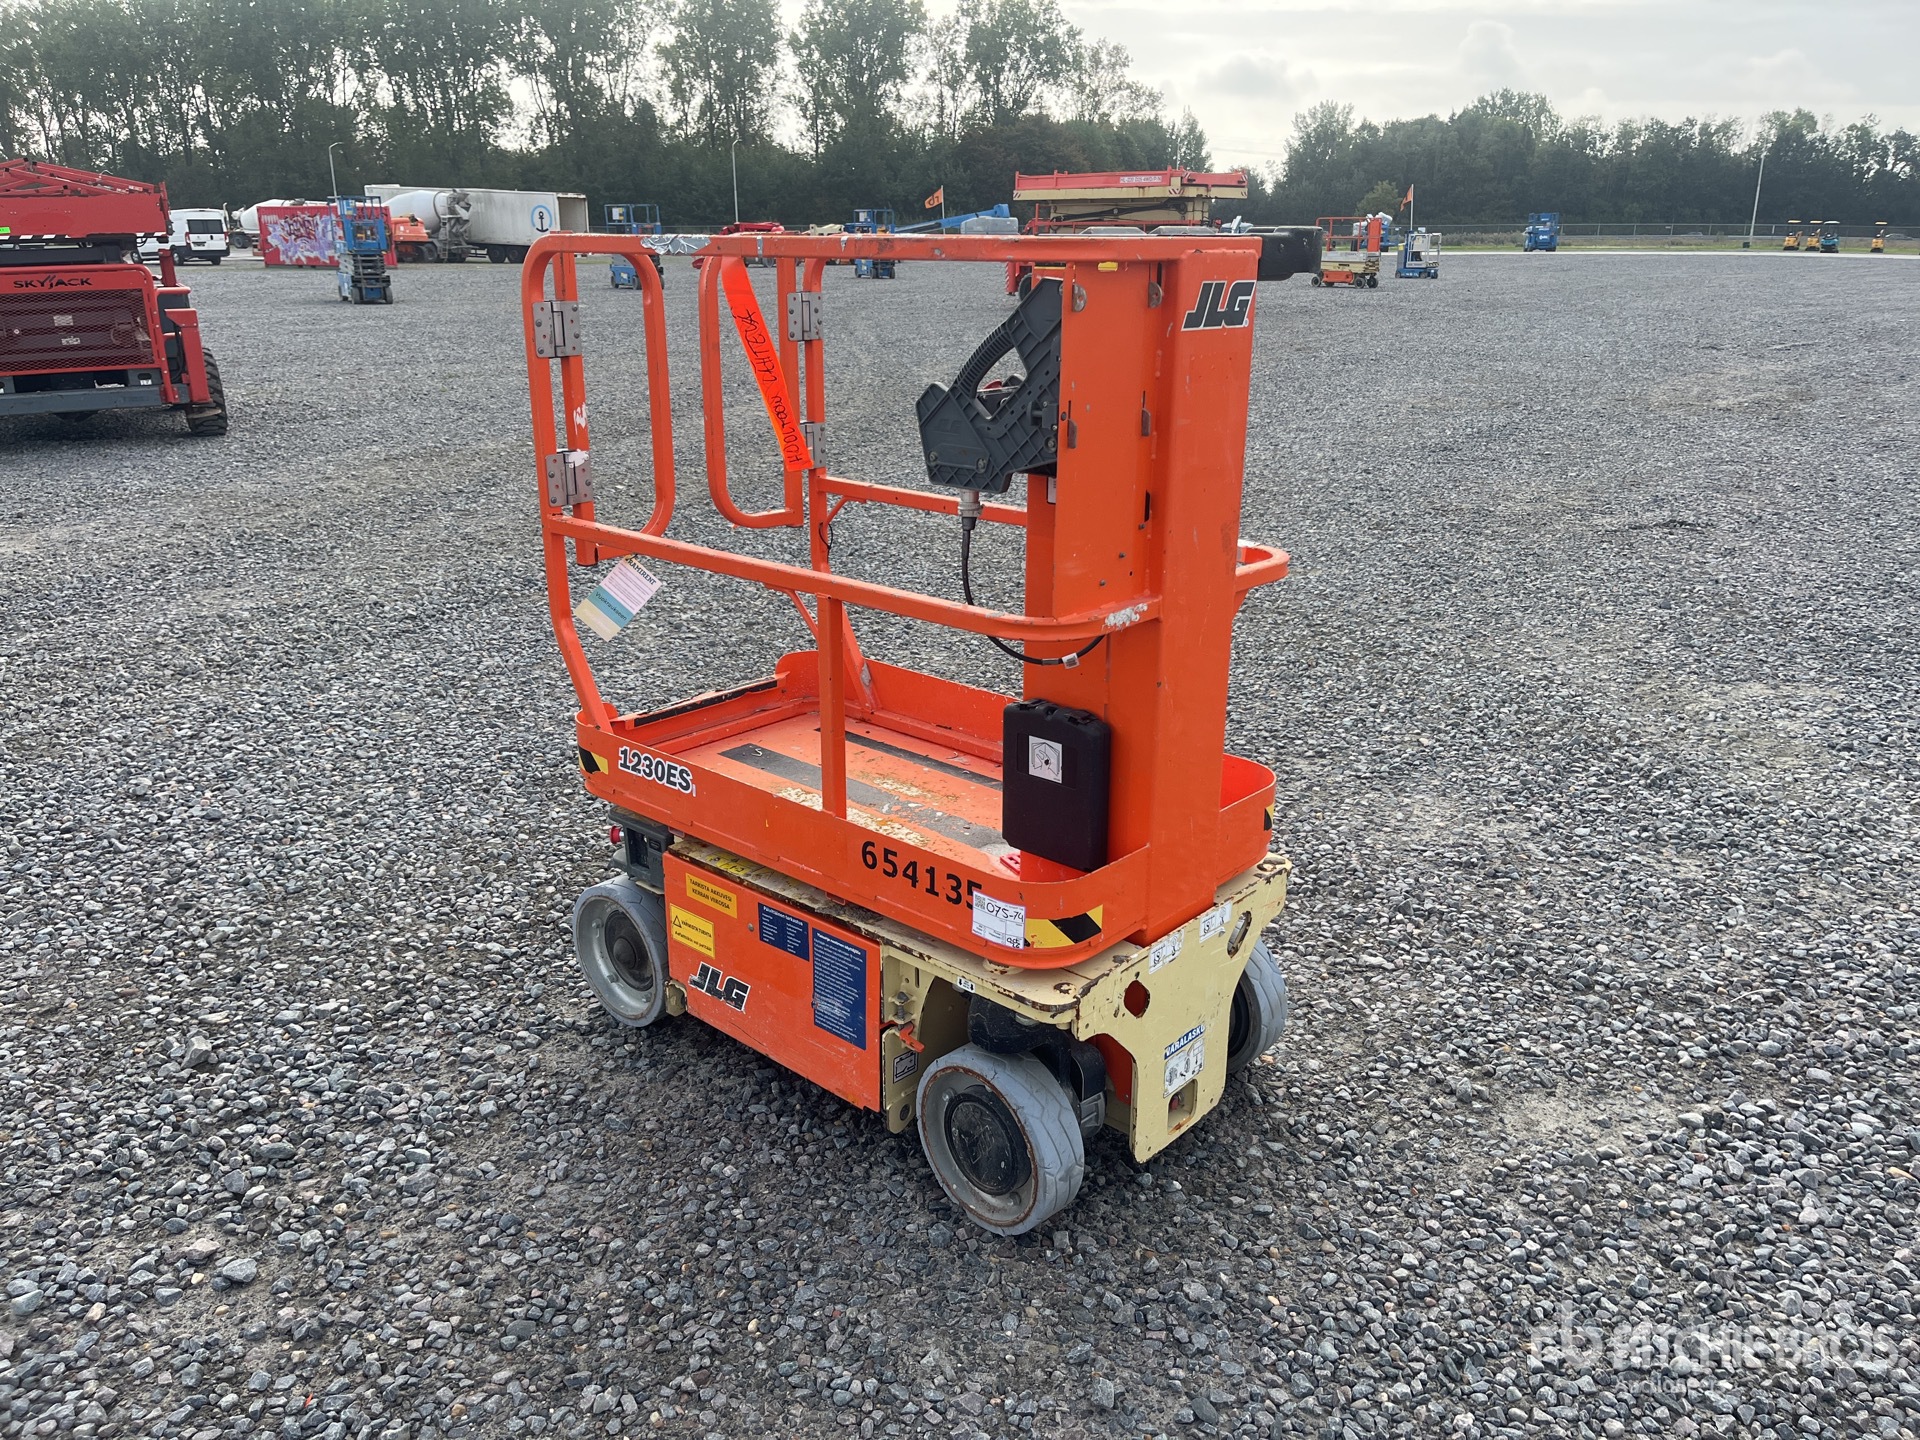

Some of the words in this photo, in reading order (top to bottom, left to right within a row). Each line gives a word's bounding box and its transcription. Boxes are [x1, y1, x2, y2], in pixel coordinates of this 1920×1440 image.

[13, 275, 92, 290] SKYJACK
[1181, 279, 1257, 331] JLG
[626, 558, 656, 585] RAMIRENT
[619, 746, 692, 793] 1230ES
[690, 878, 710, 892] TARKISTA
[689, 961, 752, 1012] JLG
